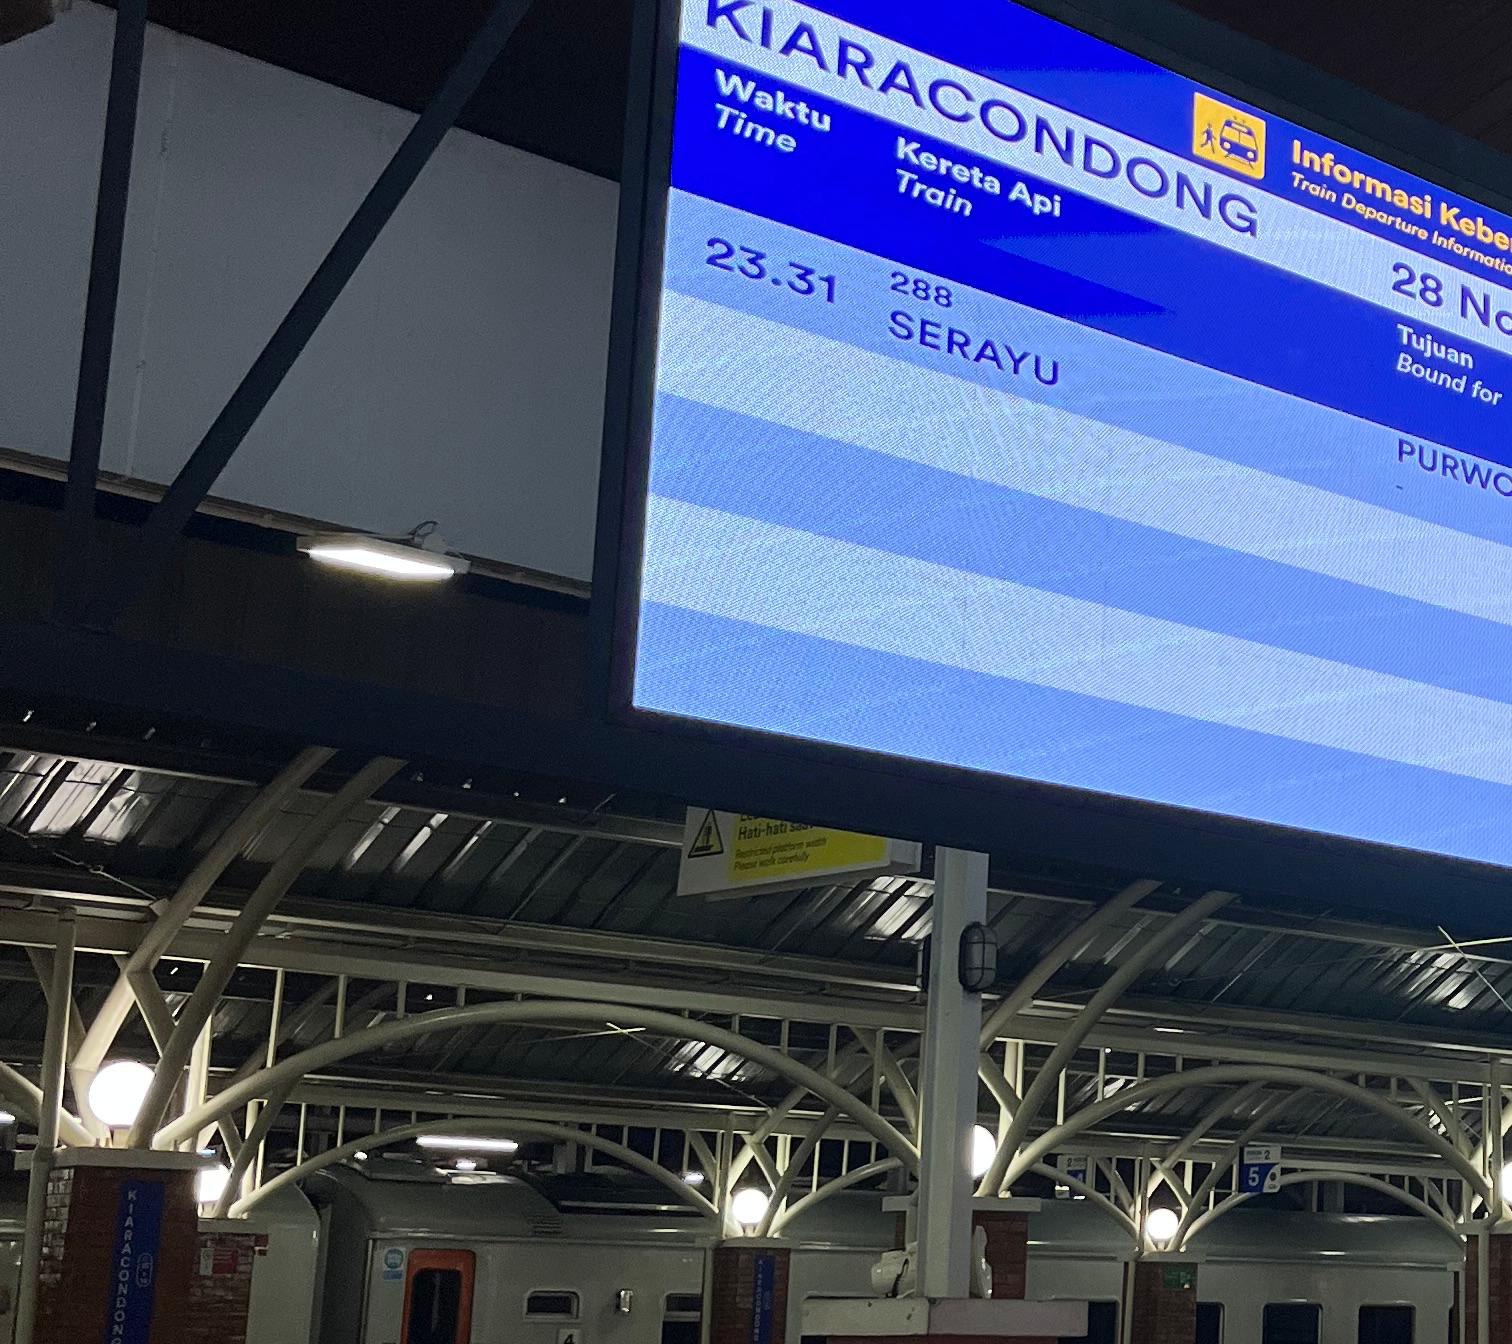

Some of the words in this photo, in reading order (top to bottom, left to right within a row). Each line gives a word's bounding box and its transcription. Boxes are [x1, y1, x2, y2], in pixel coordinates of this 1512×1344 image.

[715, 68, 831, 132] Waktu
[715, 103, 797, 153] Time
[896, 136, 1001, 195] Kereta
[1008, 181, 1062, 217] Api
[896, 168, 973, 217] Train
[1292, 139, 1432, 219] Informasi
[1291, 171, 1337, 203] Train
[1341, 192, 1428, 240] Departure
[706, 237, 836, 304] 23.31
[890, 271, 953, 308] 288
[1391, 261, 1444, 307] 28
[888, 310, 1060, 386] SERAYU
[1397, 323, 1474, 369] Tujuan
[1396, 352, 1467, 393] Bound
[1471, 380, 1503, 406] for
[1248, 1167, 1260, 1186] 5
